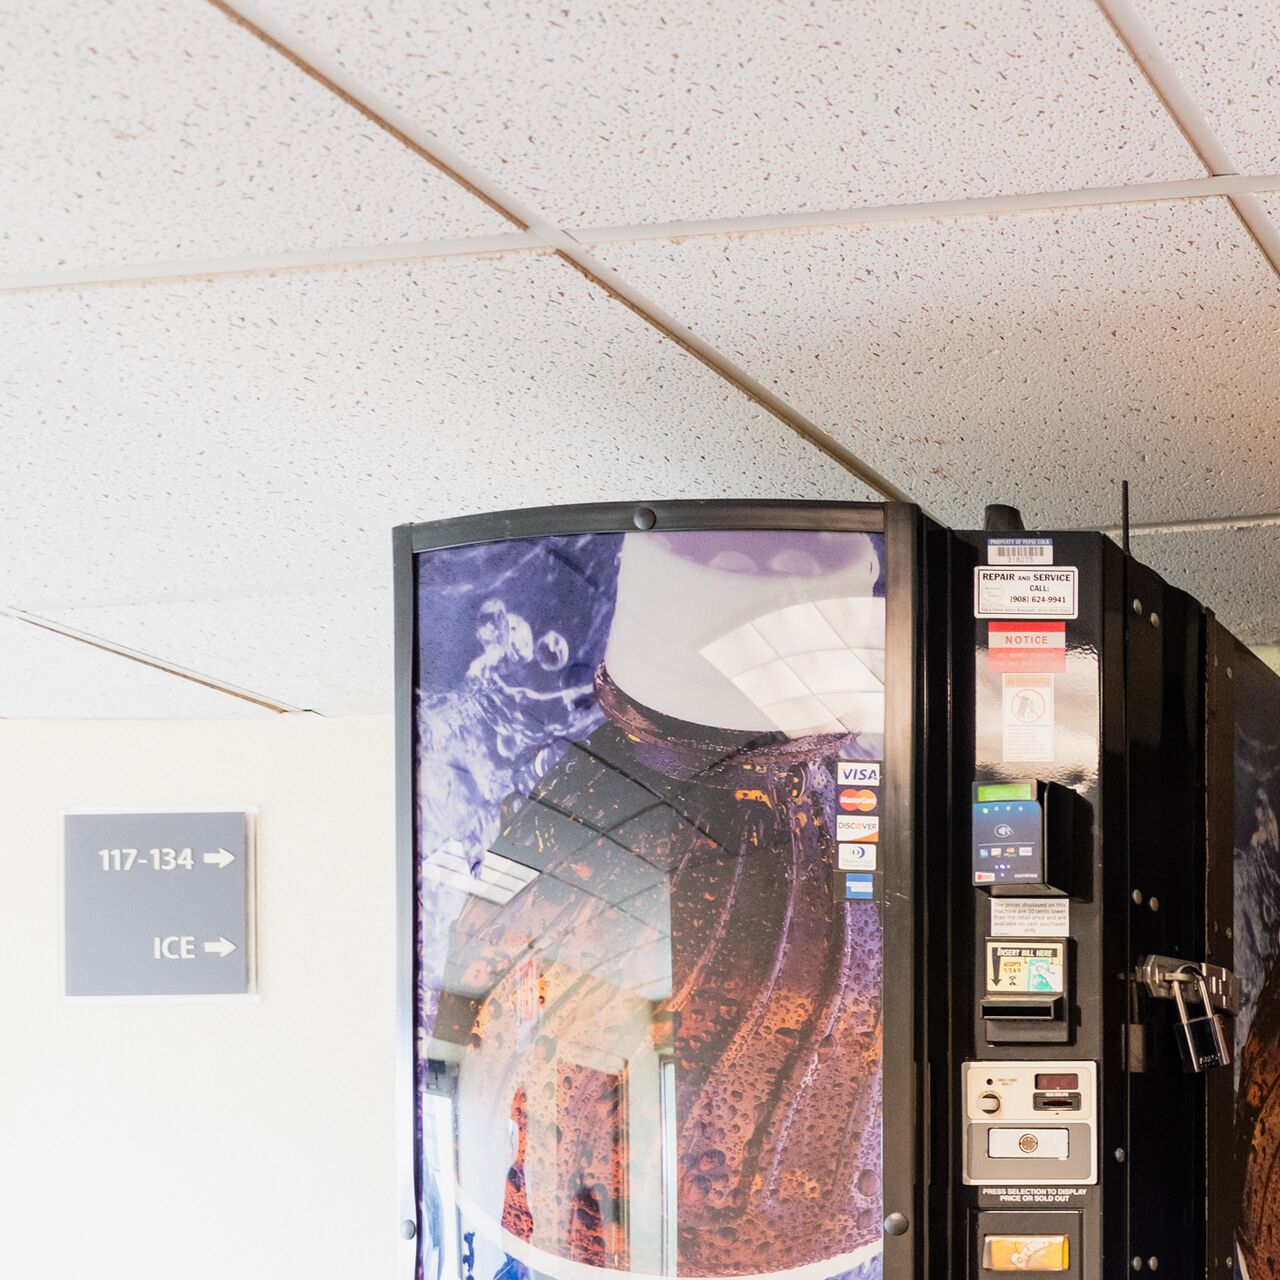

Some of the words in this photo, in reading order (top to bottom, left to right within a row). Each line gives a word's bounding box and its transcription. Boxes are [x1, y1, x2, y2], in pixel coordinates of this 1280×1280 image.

[982, 573, 1015, 581] REPAIR
[1033, 573, 1071, 582] SERVICE
[1031, 596, 1066, 604] 624-9941
[1005, 635, 1048, 645] NOTICE
[842, 768, 878, 781] VISA
[838, 821, 877, 831] DISCOVER
[99, 847, 195, 871] 117-134
[154, 936, 196, 959] ICE
